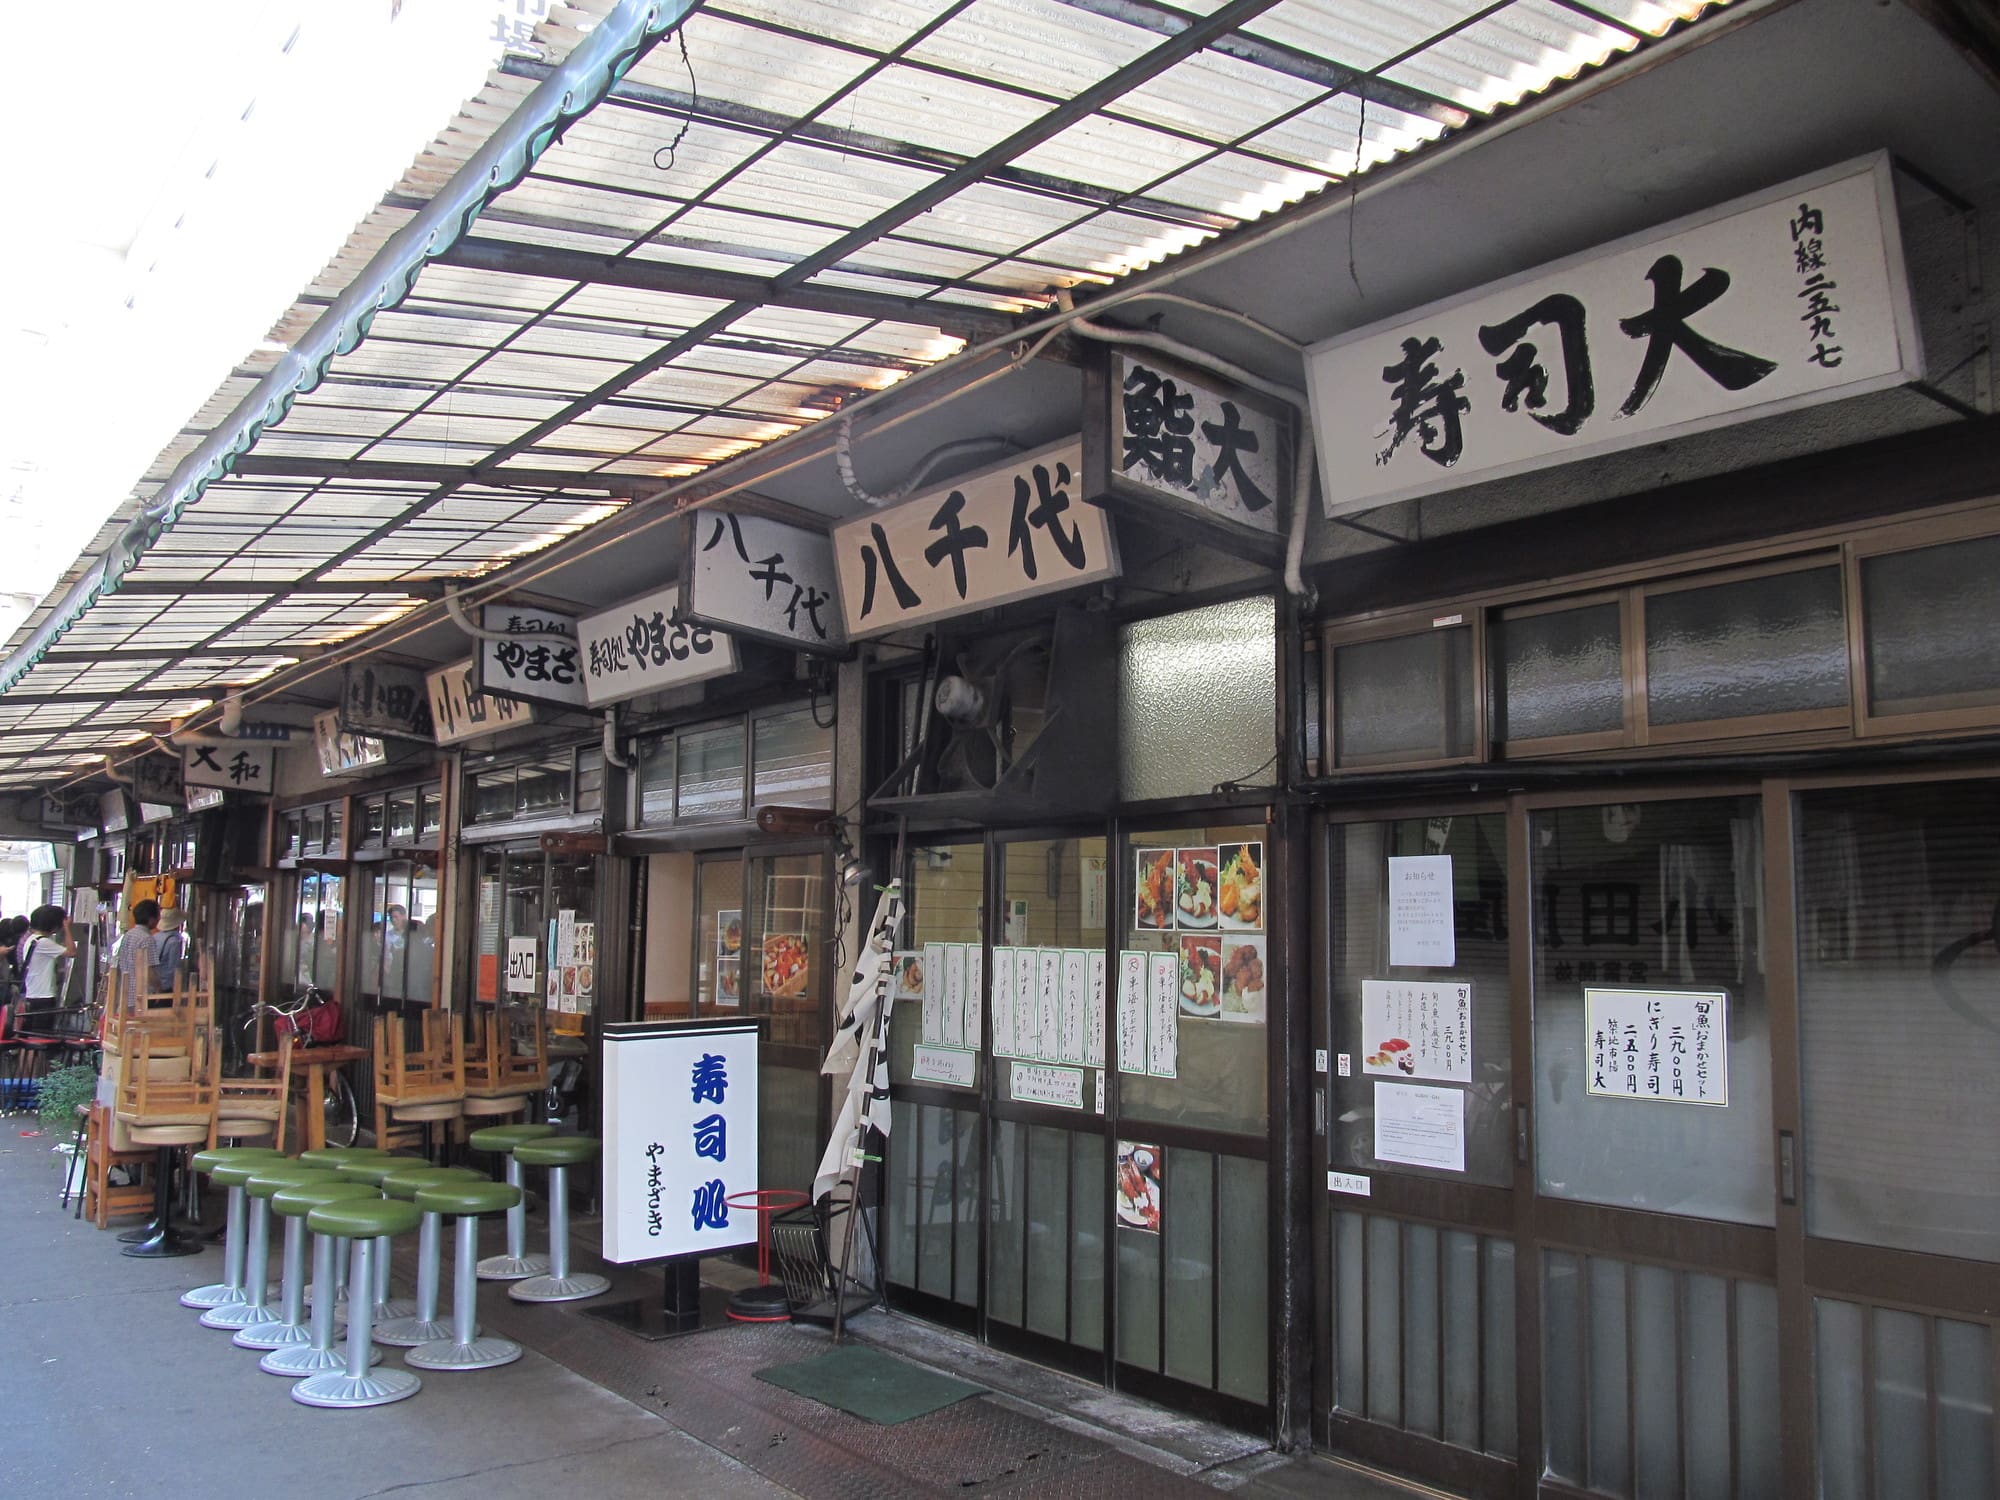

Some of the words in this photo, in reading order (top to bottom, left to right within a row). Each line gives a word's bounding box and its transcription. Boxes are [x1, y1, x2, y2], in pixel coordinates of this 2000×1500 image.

[1790, 203, 1843, 368] 内線二五九七
[1374, 255, 1779, 467] 寿司大
[703, 512, 830, 639] 八千代
[860, 461, 1086, 621] 八千代
[589, 636, 629, 678] 寿司処
[190, 746, 261, 785] 大和
[1404, 871, 1436, 881] お知らせ
[1593, 1030, 1607, 1089] 寿司大
[1608, 1018, 1619, 1073] 築地市場
[1647, 1001, 1664, 1095] にぎり寿司
[645, 1141, 667, 1237] やまざき
[691, 1053, 729, 1232] 寿司処
[1333, 1175, 1364, 1191] 出入口
